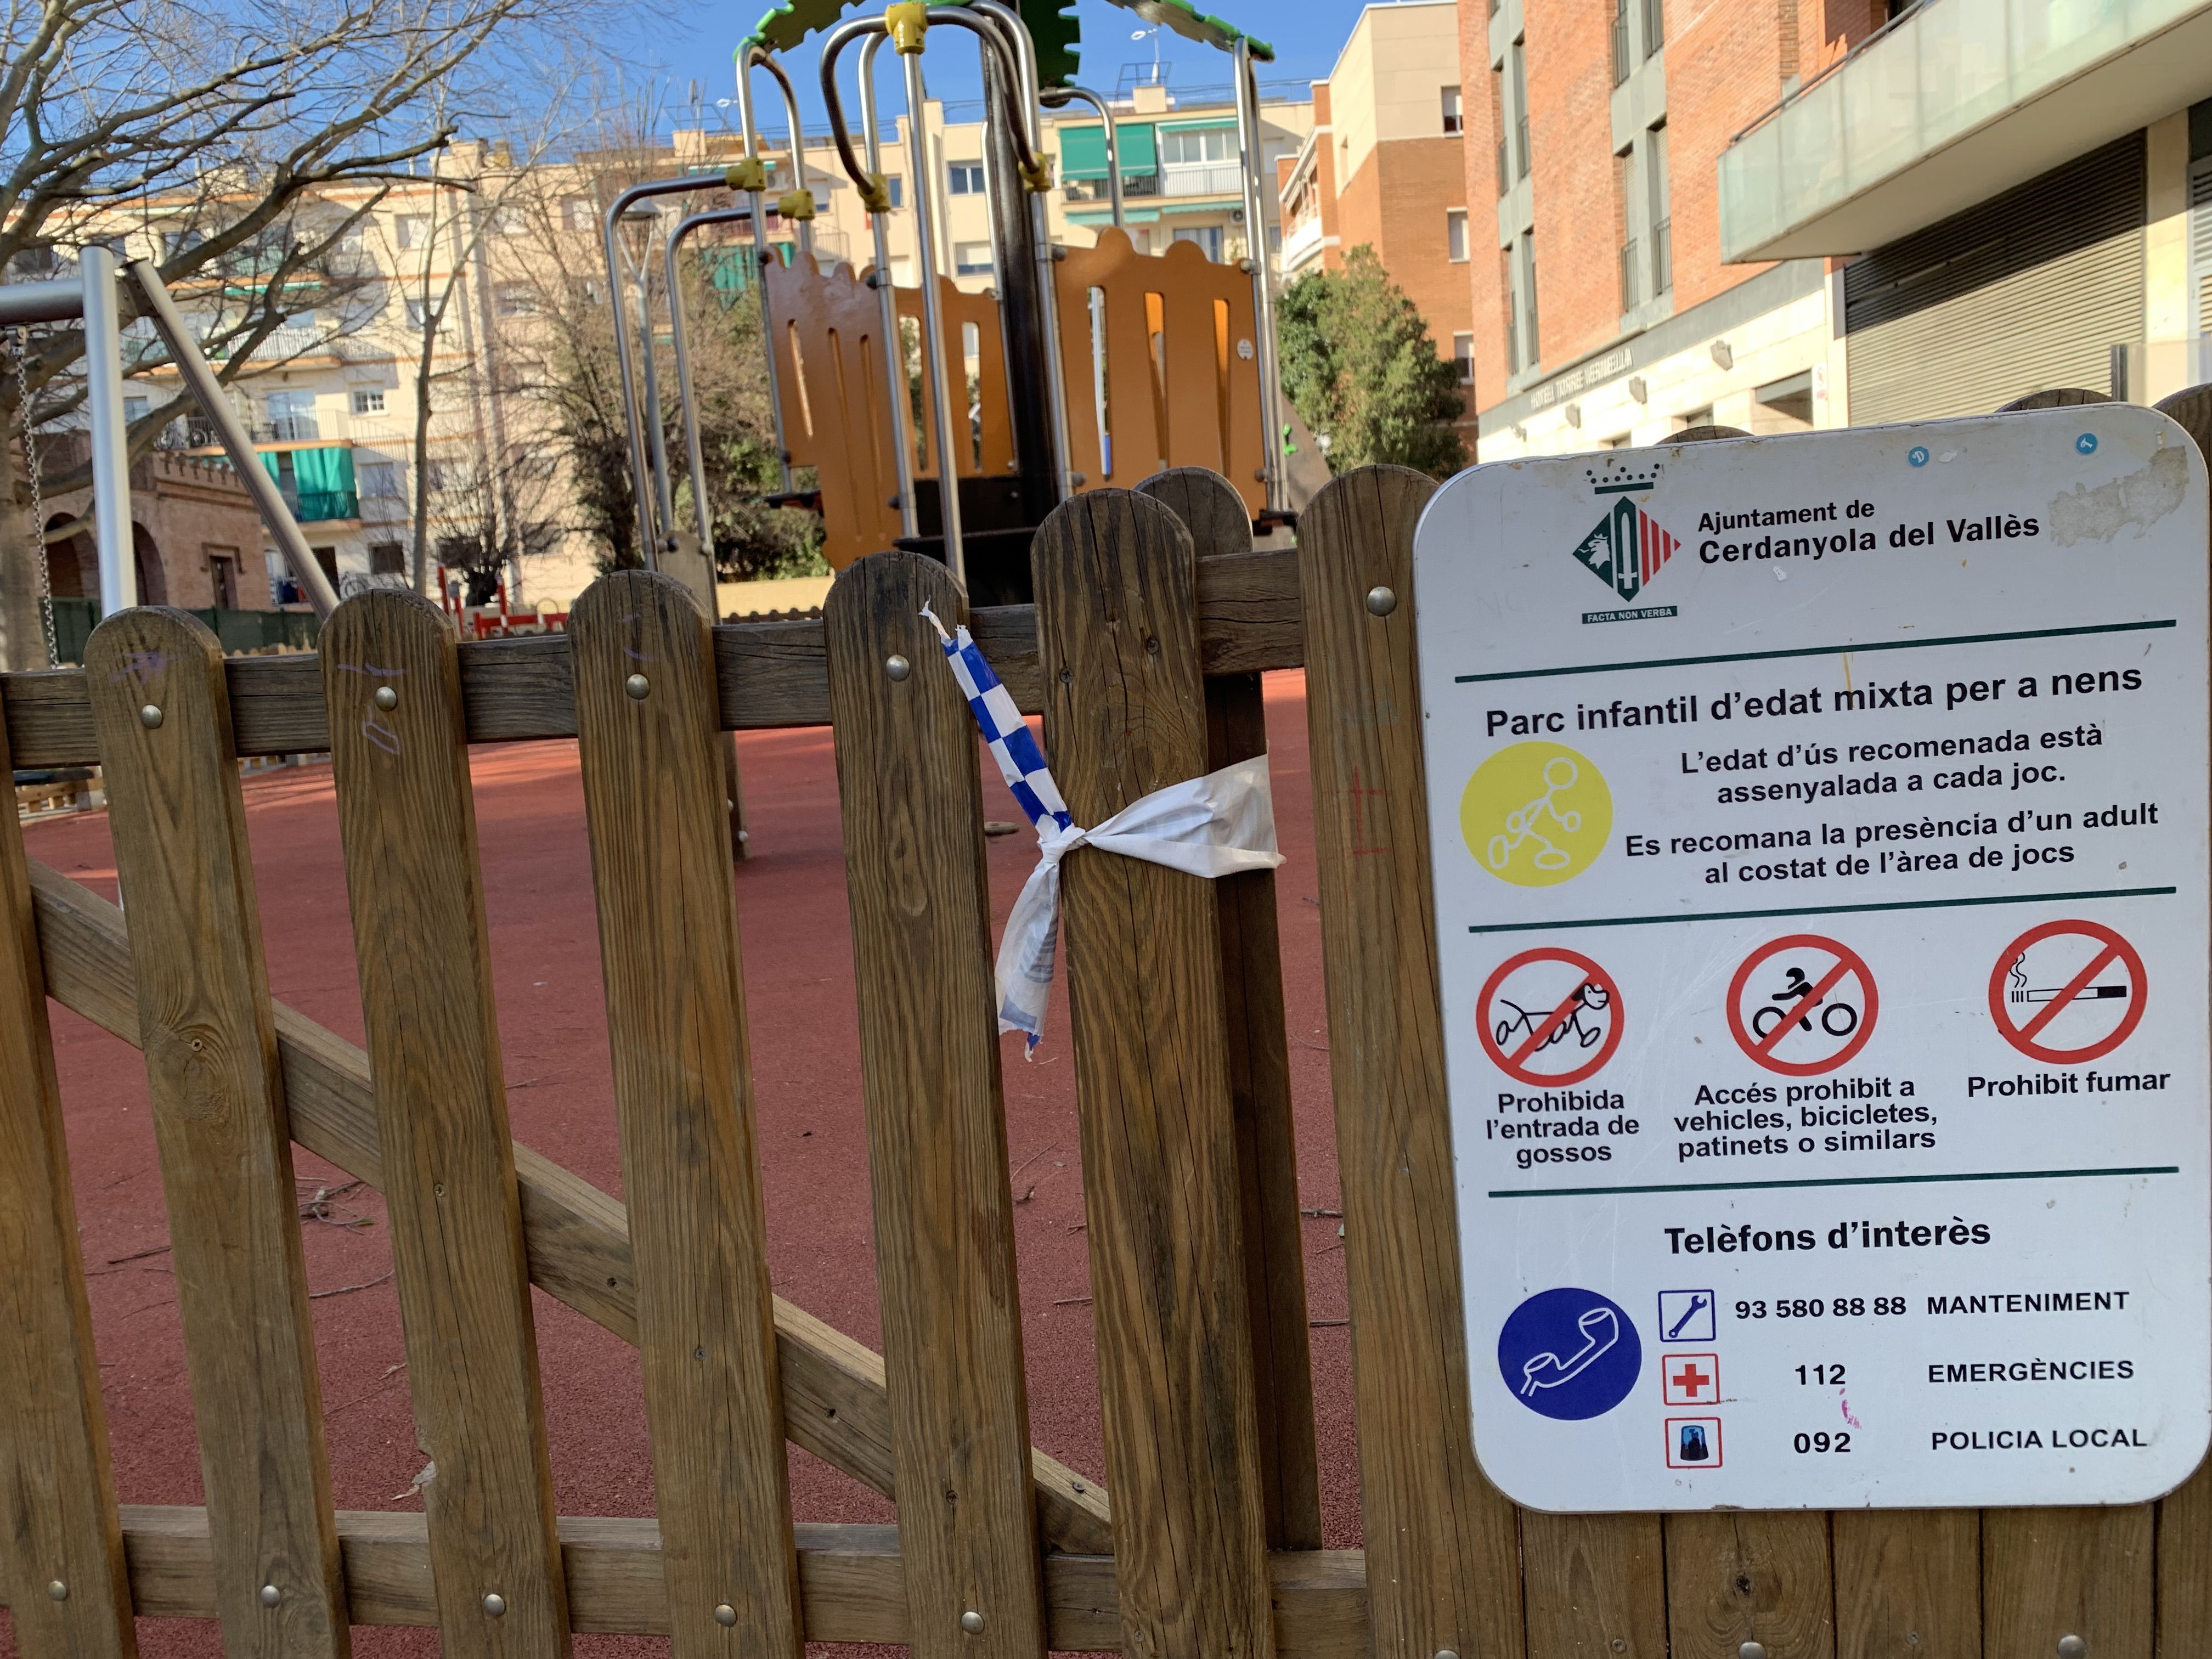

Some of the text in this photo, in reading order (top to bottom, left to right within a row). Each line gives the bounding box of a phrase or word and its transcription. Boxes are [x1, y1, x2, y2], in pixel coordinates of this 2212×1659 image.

[1698, 499, 1875, 535] Ajuntament de
[1699, 514, 2039, 564] Cerdanyola del Vallès
[1587, 608, 1672, 623] FACTA NON VERBA
[1487, 669, 2142, 737] Parc infantil d'edat mixta per a nens
[1681, 723, 2103, 774] L'edat d'ús recomenada està
[1718, 762, 2065, 804] assenyalada a cada joc.
[1626, 803, 2158, 857] Es recomana la presència d'un adult
[1705, 843, 2075, 884] al costat de l'àrea de jocs
[1694, 1077, 1915, 1107] Accés prohibit a
[1968, 1071, 2171, 1098] Prohibit fumar
[1498, 1089, 1625, 1114] Prohibida
[1486, 1114, 1640, 1140] l'entrada de
[1673, 1103, 1937, 1132] vehicles, bicicletes,
[1516, 1146, 1612, 1170] gossos
[1678, 1128, 1936, 1163] patinets o similars
[1664, 1215, 1991, 1254] Telèfons d'interès
[1735, 1291, 2130, 1319] 93 580 88 88 MANTENIMENT
[1795, 1358, 2134, 1385] 112 EMERGÈNCIES
[1793, 1429, 2148, 1454] 092 POLICIA LOCAL
